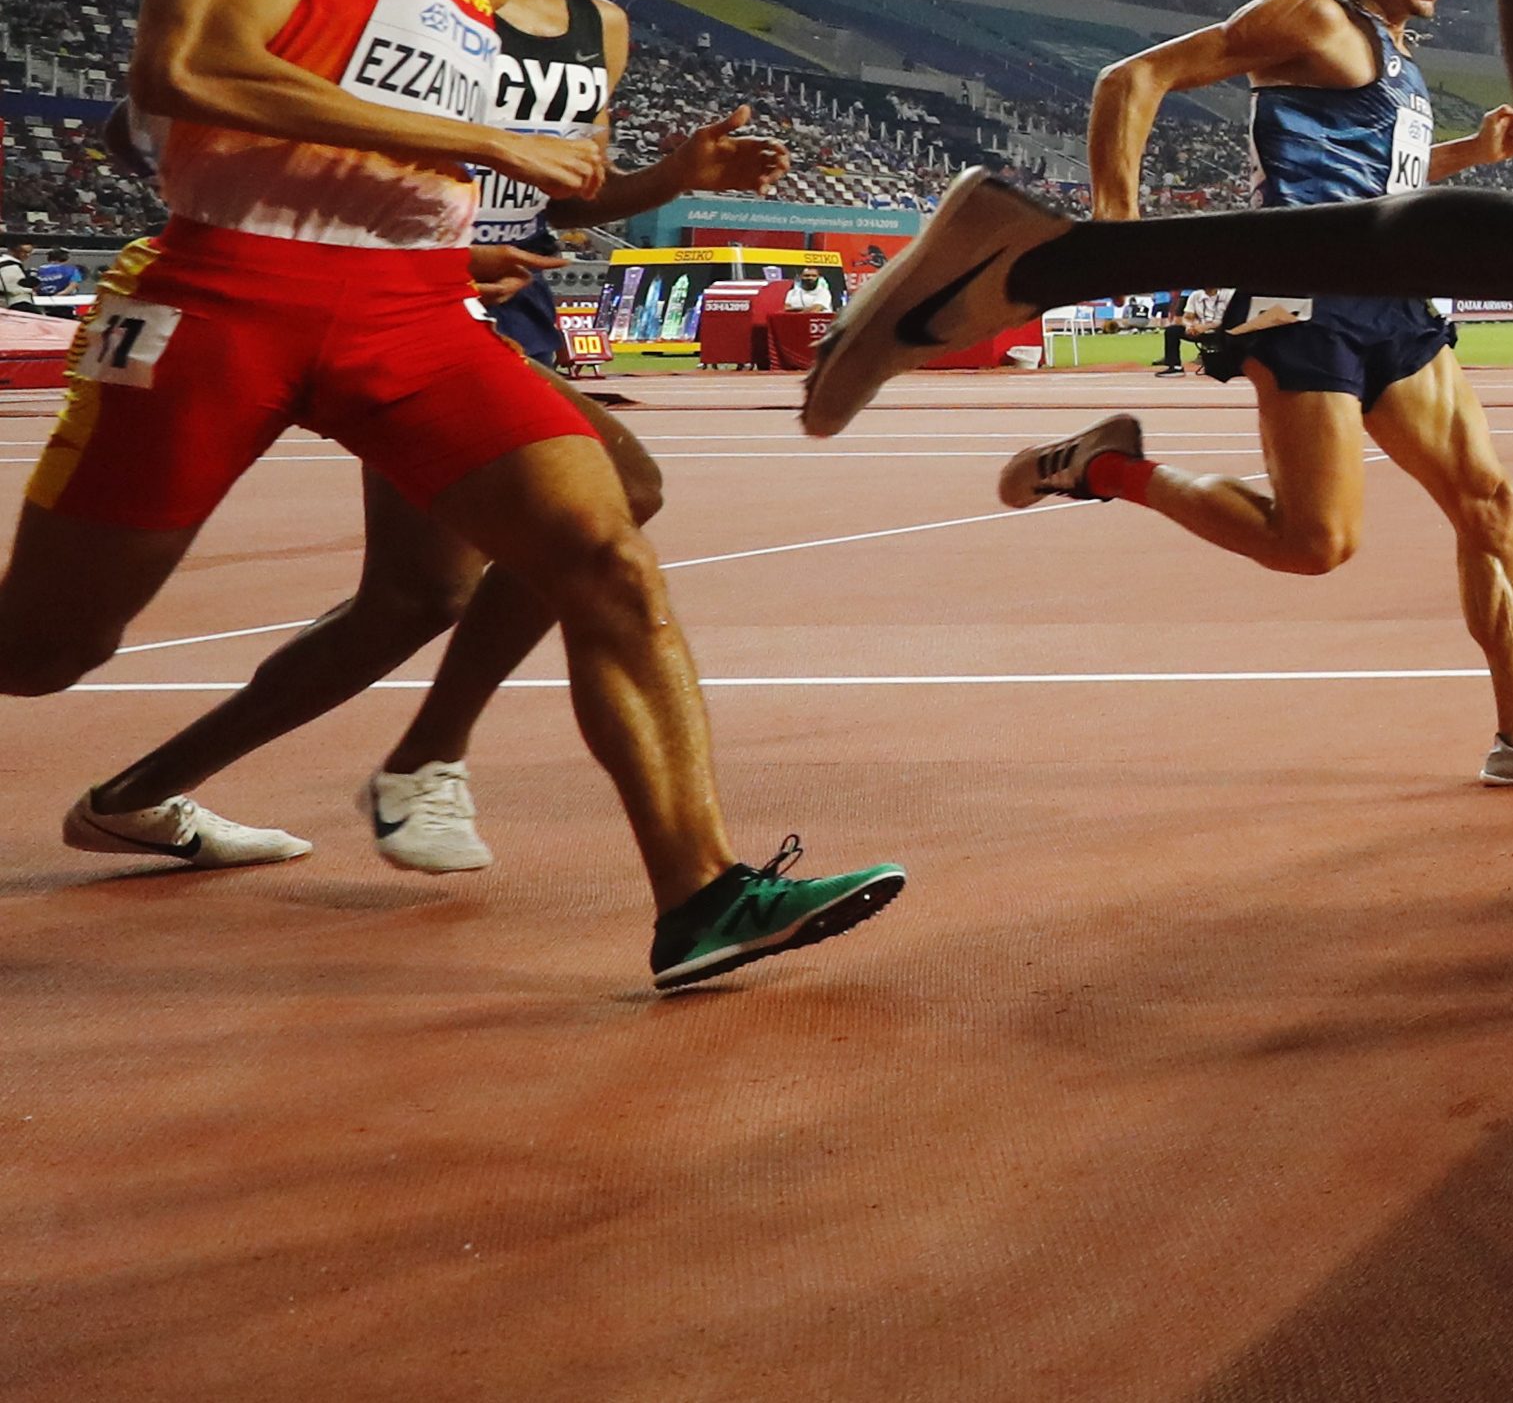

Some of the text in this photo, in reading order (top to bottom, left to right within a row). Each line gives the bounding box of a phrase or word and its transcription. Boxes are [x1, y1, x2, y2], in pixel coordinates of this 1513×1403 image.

[451, 12, 497, 64] TDK
[495, 53, 609, 125] GYPT
[687, 210, 718, 221] IAAF
[720, 212, 749, 223] World
[674, 250, 714, 262] SEIKO
[804, 253, 840, 265] SEIKO
[560, 316, 594, 329] DOH
